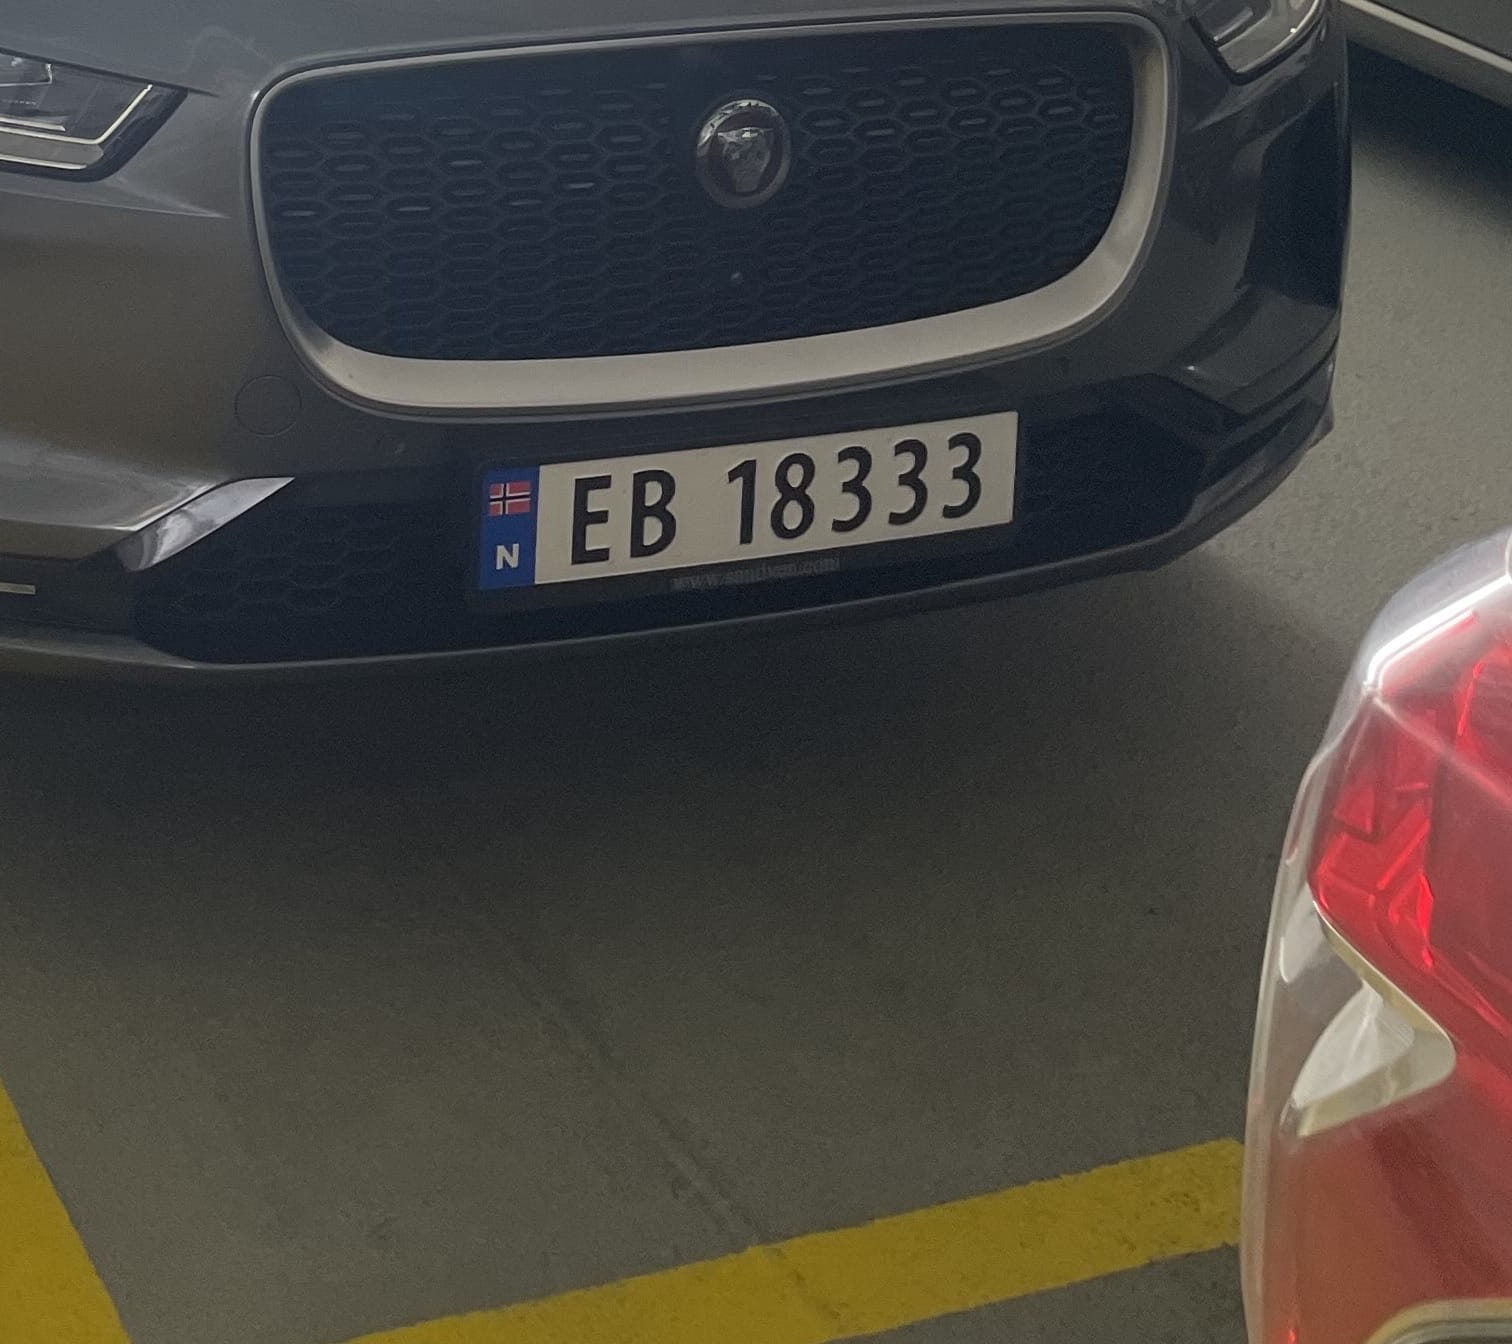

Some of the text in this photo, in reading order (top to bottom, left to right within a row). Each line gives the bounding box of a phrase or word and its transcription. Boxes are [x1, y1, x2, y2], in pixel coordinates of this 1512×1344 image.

[571, 432, 982, 566] EB 18333
[496, 543, 519, 570] N
